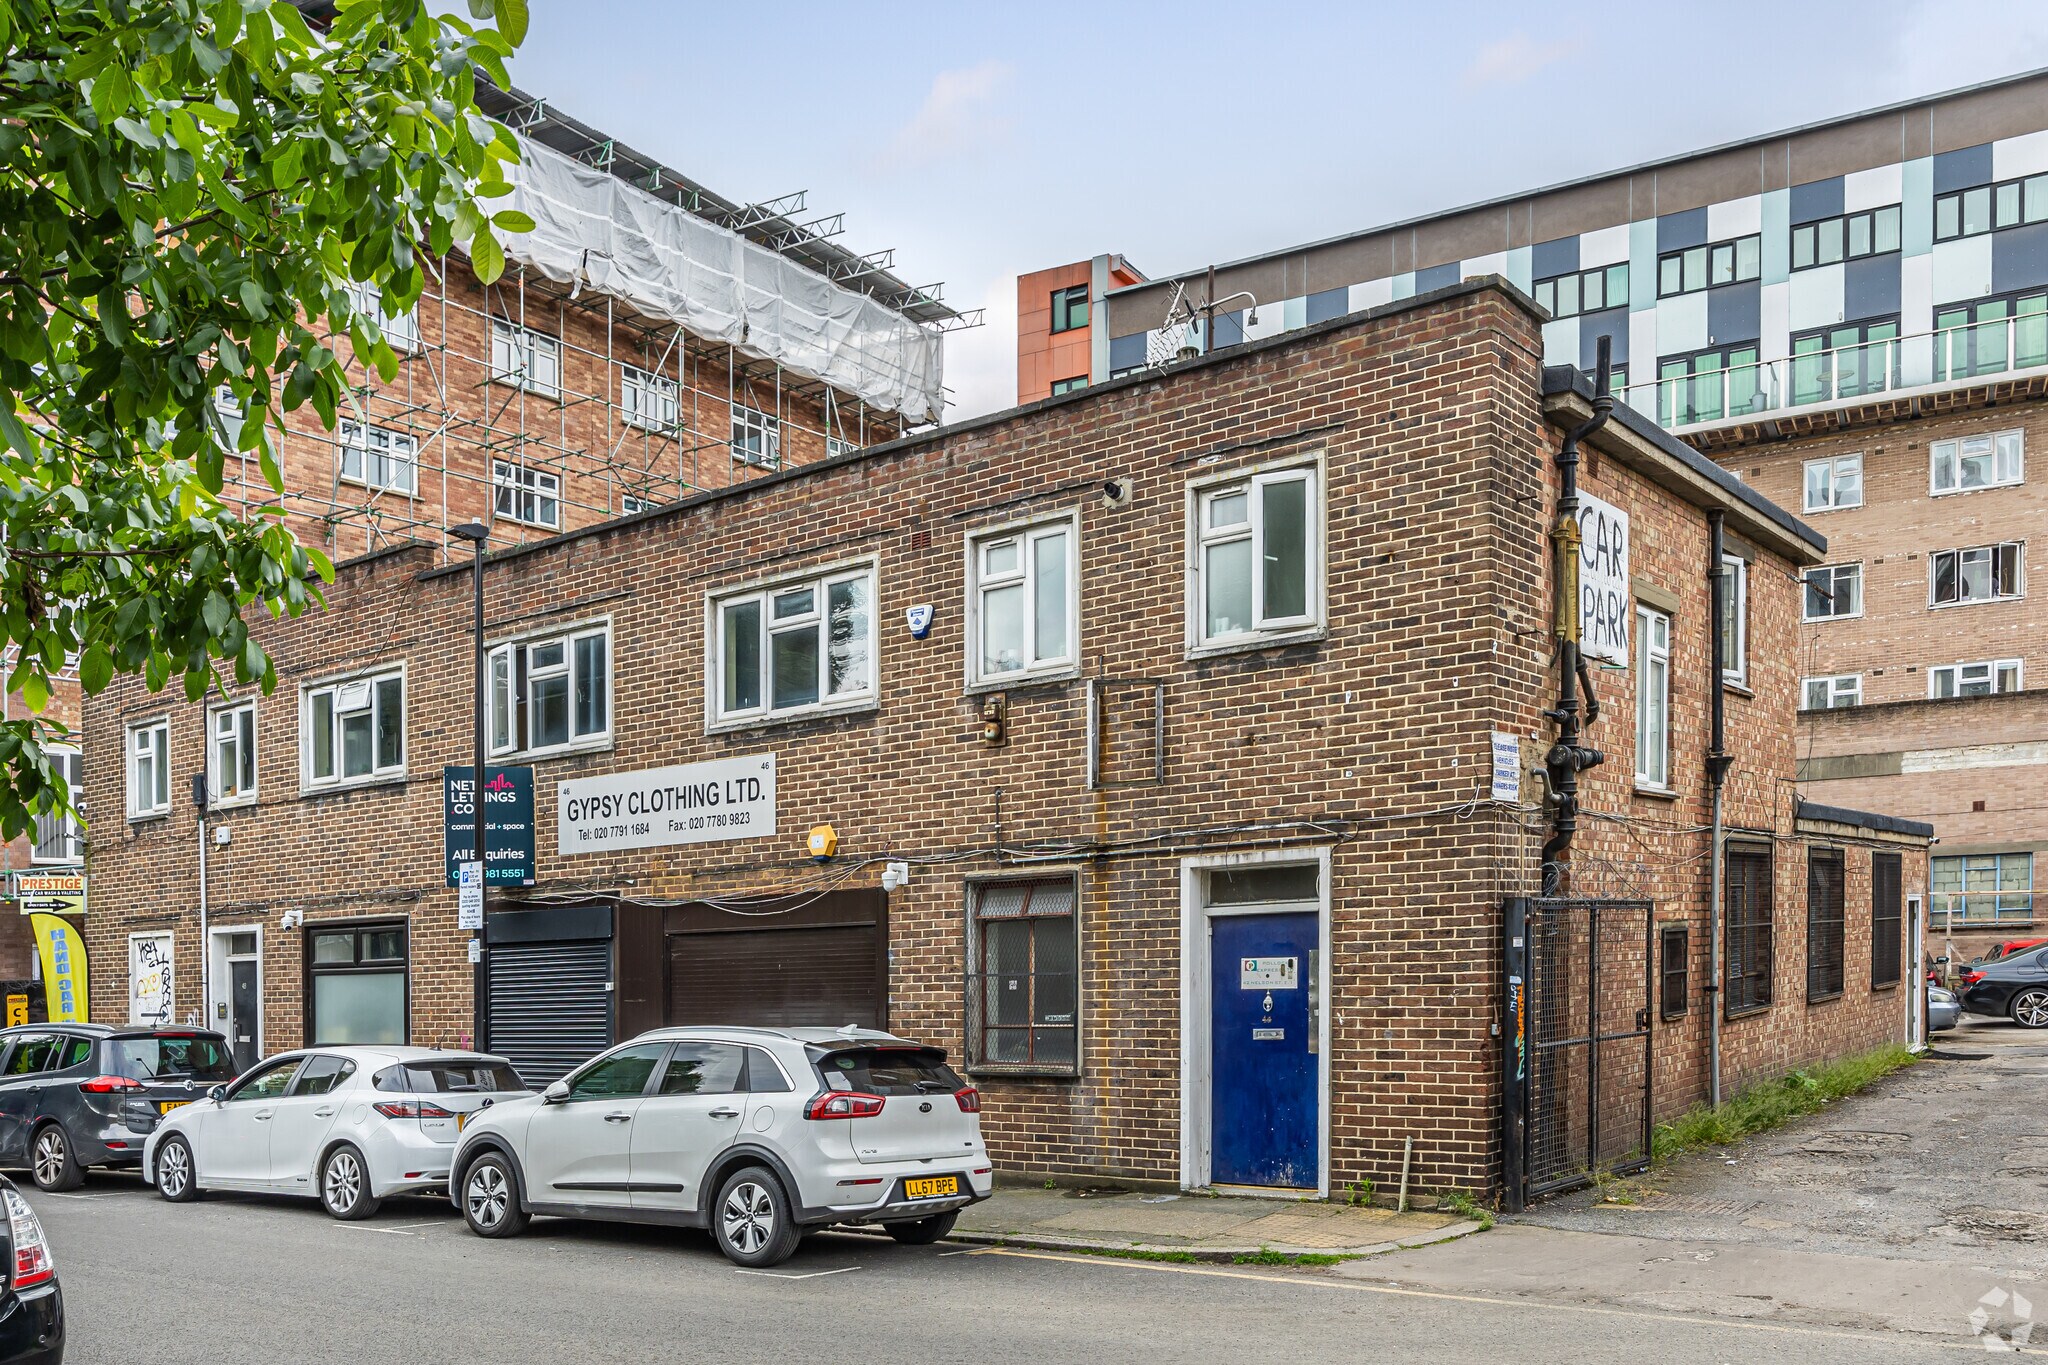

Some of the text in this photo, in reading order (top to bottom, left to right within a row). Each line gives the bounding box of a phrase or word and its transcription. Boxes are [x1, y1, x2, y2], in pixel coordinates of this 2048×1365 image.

[1579, 506, 1623, 581] CAR
[1584, 584, 1627, 649] PARK
[761, 761, 770, 770] 46
[451, 792, 517, 803] LETINGS
[562, 787, 571, 796] 46
[567, 777, 766, 822] GYPSY CLOTHING LTD.
[502, 823, 525, 832] space
[668, 811, 750, 832] Fax: 020 7780 9823
[578, 822, 650, 841] Tel: 020 7791 1684
[452, 847, 525, 861] All Equiries
[485, 869, 500, 878] 981
[501, 868, 525, 878] 5551
[22, 878, 81, 889] PRESTIGE
[909, 1178, 954, 1195] LL67 BPE
